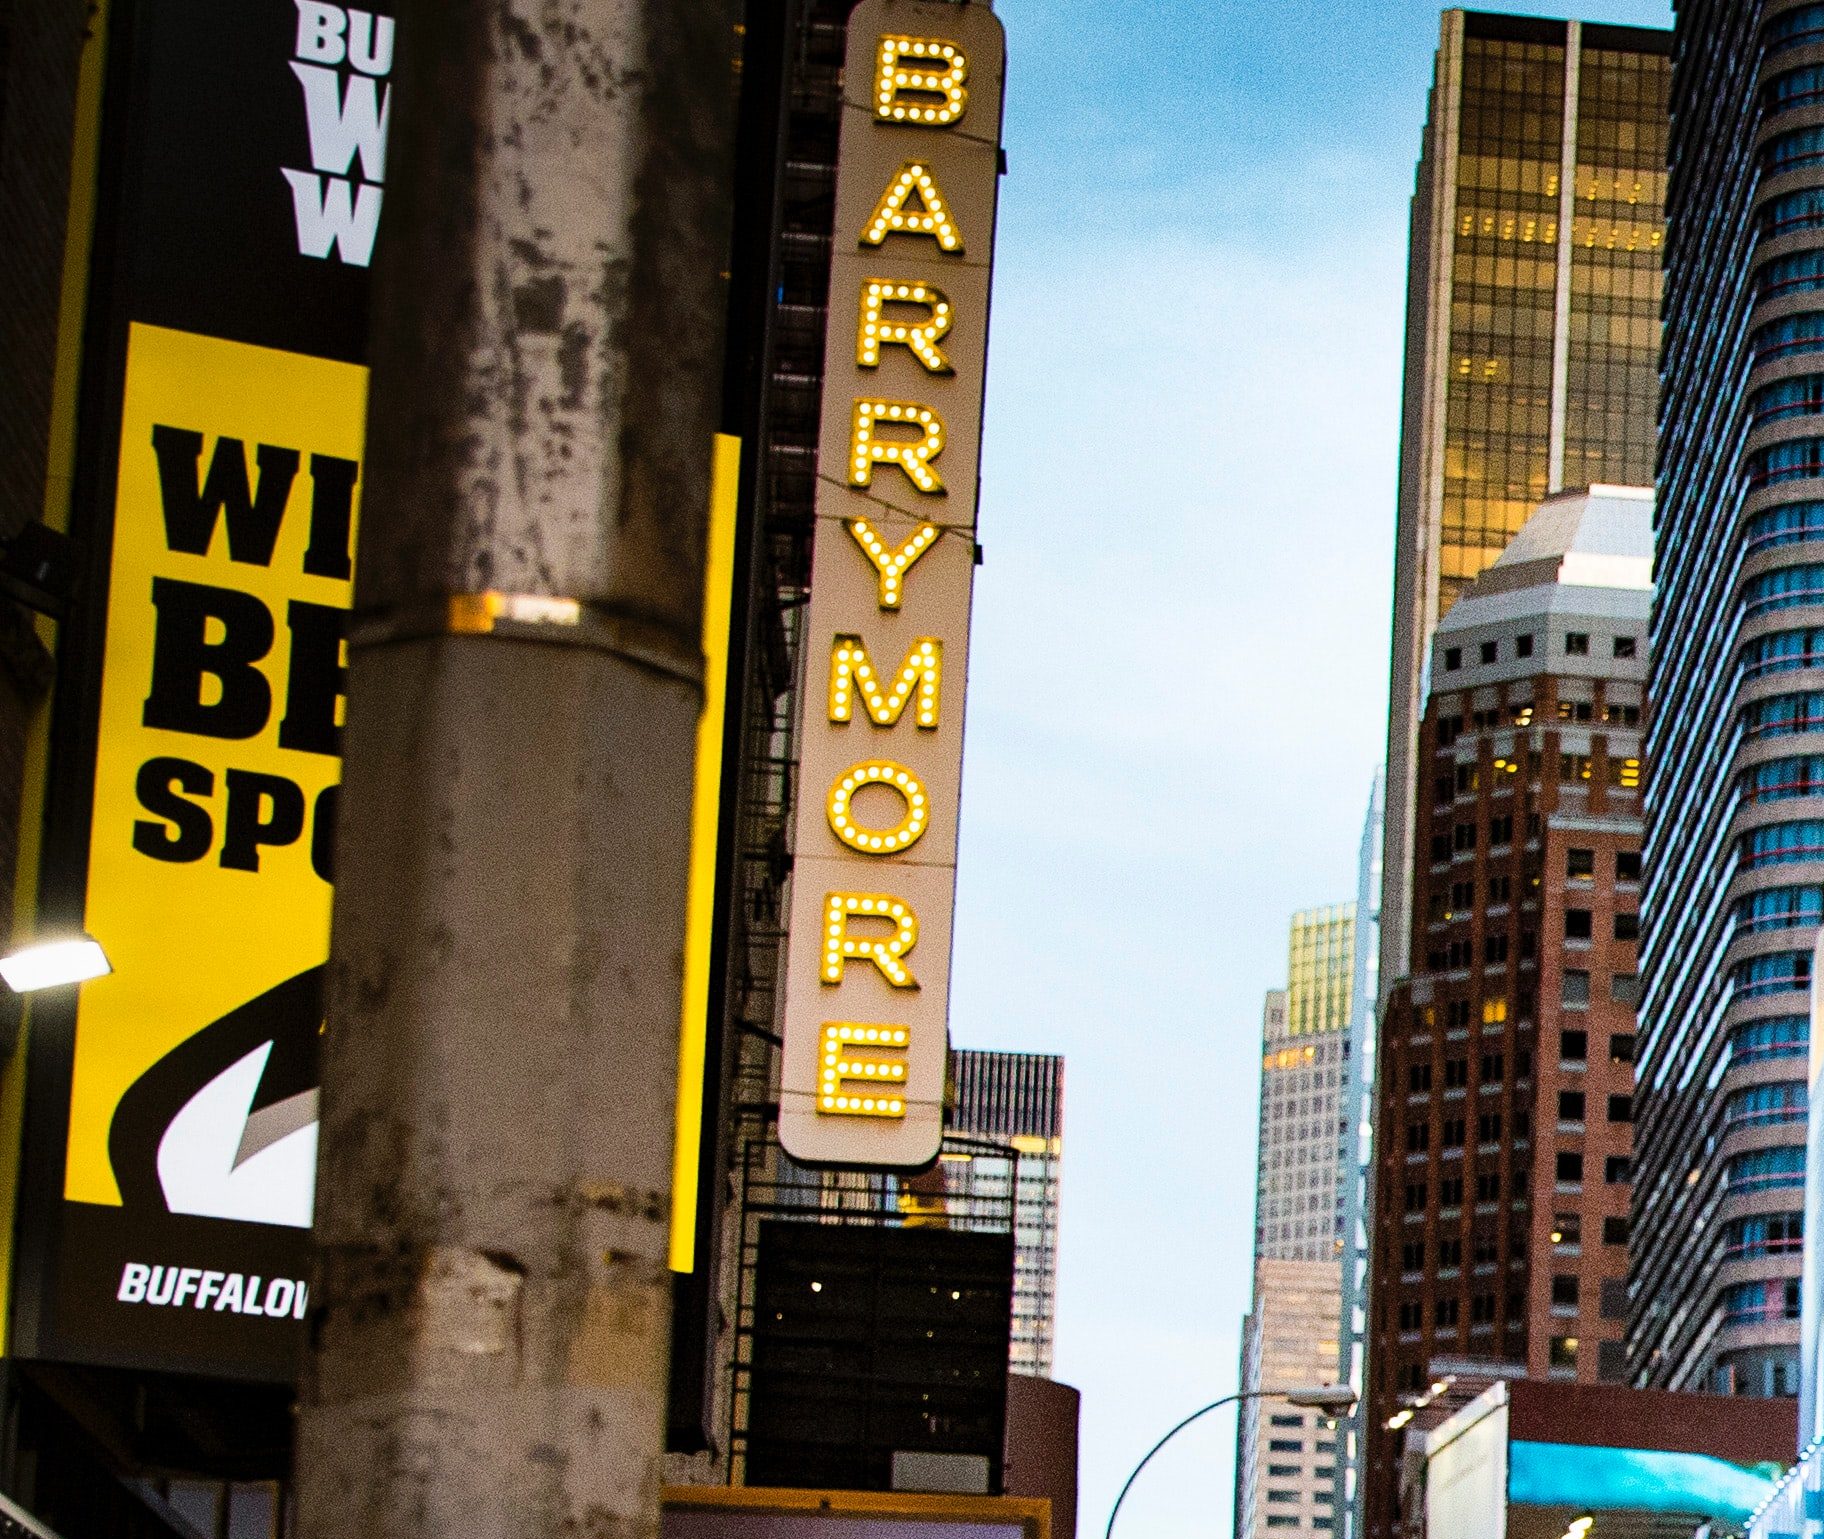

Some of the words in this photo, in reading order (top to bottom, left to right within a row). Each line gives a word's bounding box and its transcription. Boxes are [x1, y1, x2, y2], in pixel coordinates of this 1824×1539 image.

[294, 0, 395, 76] BU
[152, 424, 358, 581] WI
[815, 33, 968, 1119] BARRYMORE
[142, 576, 347, 757] BE
[132, 756, 338, 886] SP
